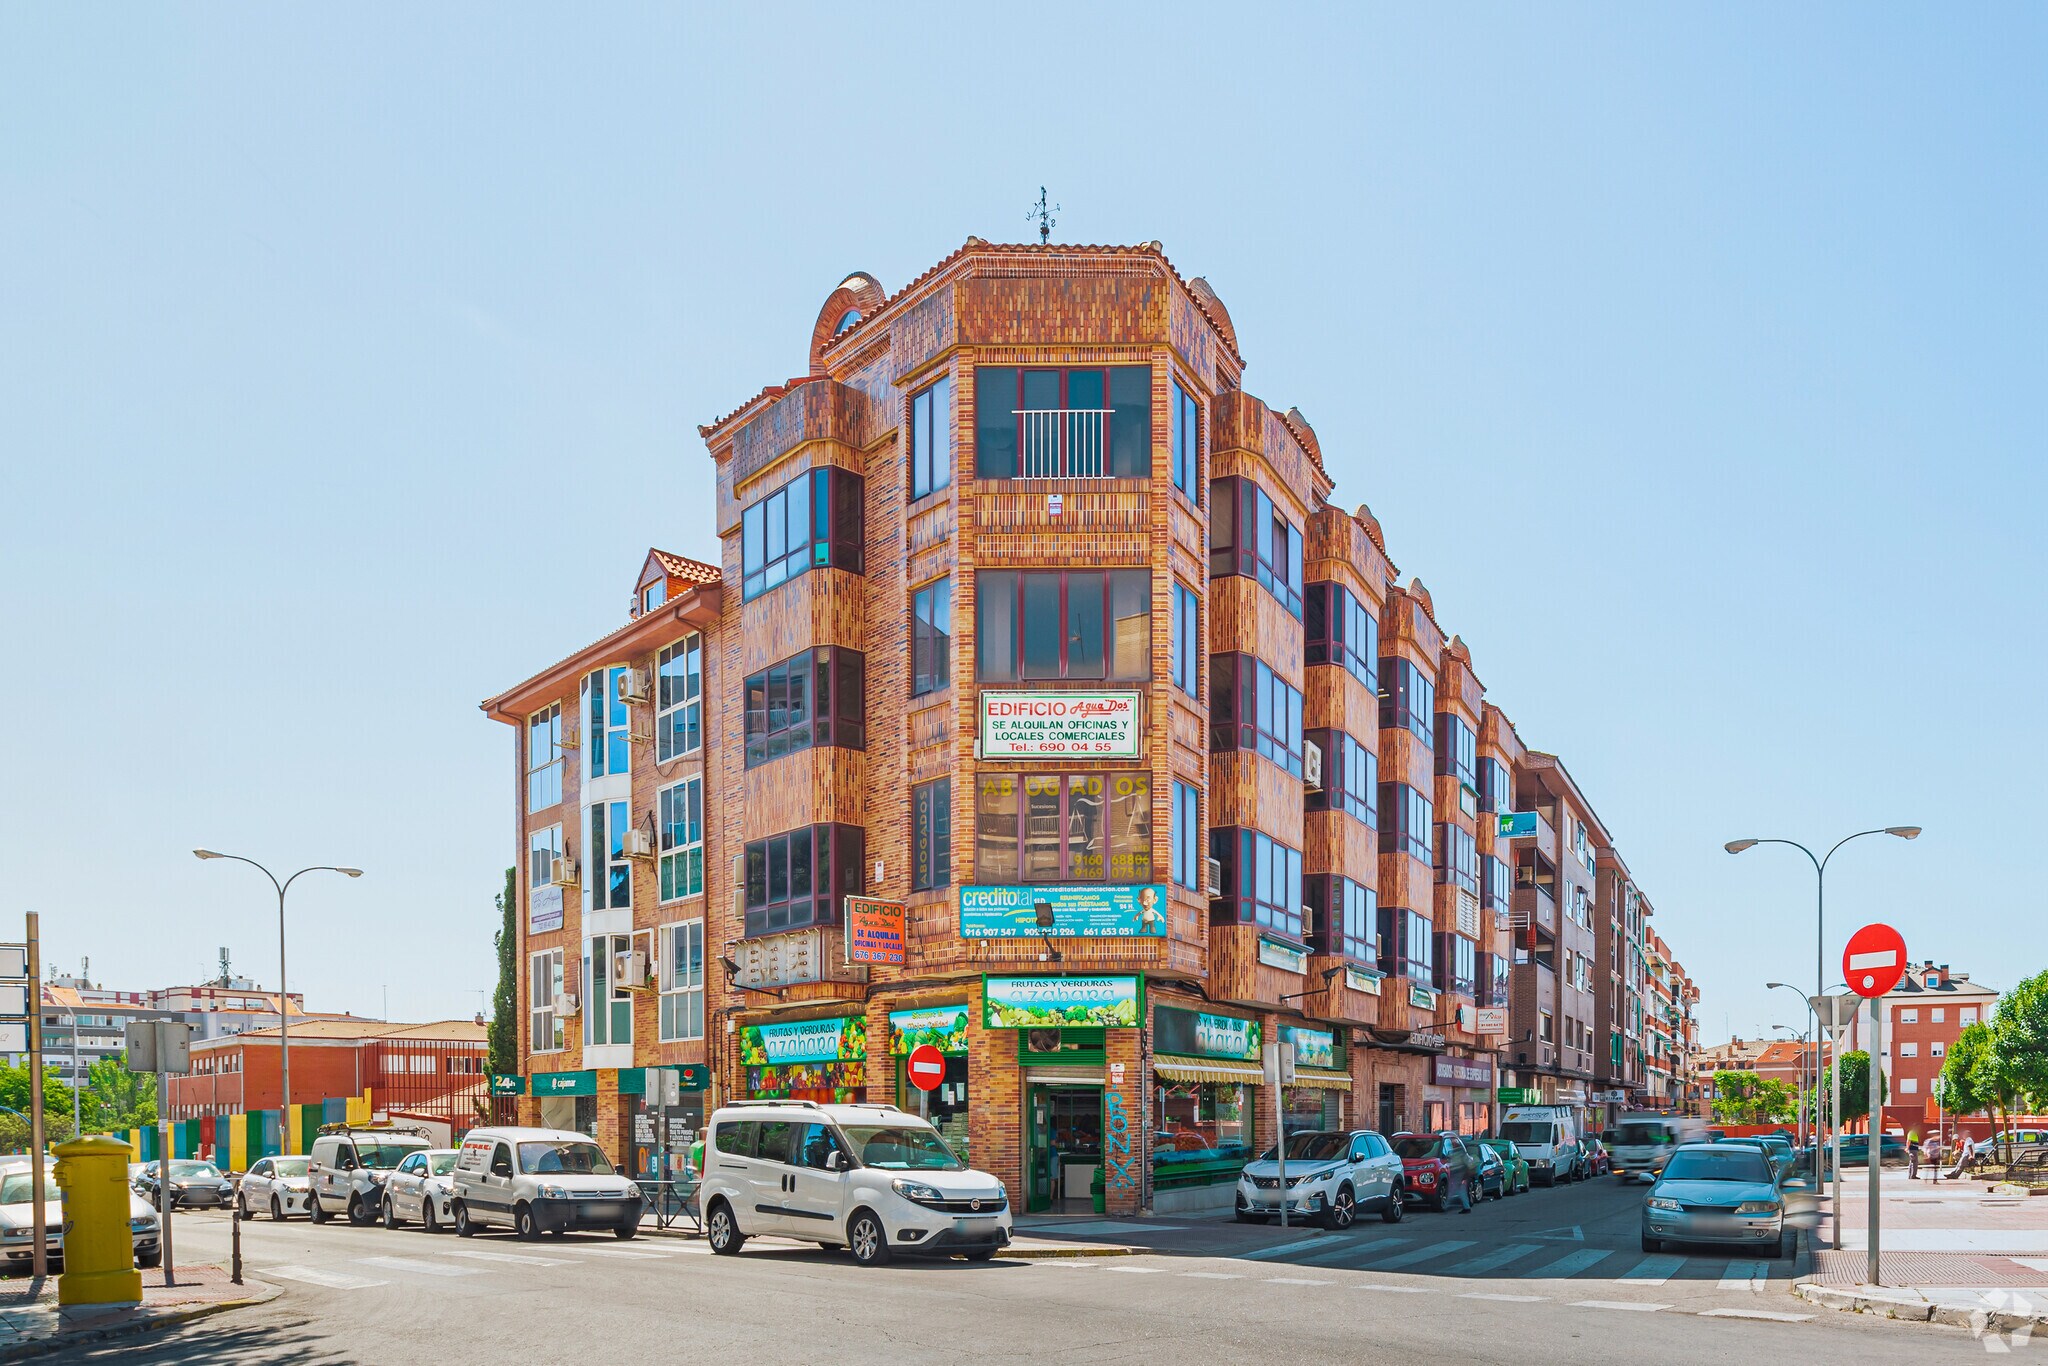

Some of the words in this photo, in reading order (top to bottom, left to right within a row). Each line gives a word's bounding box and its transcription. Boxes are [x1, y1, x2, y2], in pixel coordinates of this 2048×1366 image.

[987, 702, 1067, 716] EDIFICIO
[1069, 701, 1105, 719] Agua
[992, 720, 1006, 729] SE
[1010, 720, 1064, 730] ALQUILAN
[1067, 720, 1117, 730] OFICINAS
[1121, 720, 1129, 729] Y
[995, 731, 1044, 741] LOCALES
[1048, 731, 1126, 741] COMERCIALES
[1009, 743, 1033, 752] Tel.:
[1039, 743, 1066, 752] 690
[1071, 743, 1089, 752] 04
[1094, 743, 1112, 752] 55
[919, 789, 928, 885] ABOGADOS
[962, 887, 1033, 907] creditotal
[855, 902, 902, 917] EDIFICIO
[857, 929, 865, 938] SE
[867, 931, 900, 941] ALQUILAN
[965, 928, 981, 936] 916
[982, 928, 999, 936] 907
[1000, 928, 1017, 936] 547
[1059, 928, 1076, 936] 226
[1083, 927, 1099, 936] 661
[1101, 927, 1117, 936] 653
[1118, 927, 1135, 936] 051
[854, 949, 869, 960] 676
[871, 951, 887, 961] 367
[889, 953, 904, 963] 230
[1011, 980, 1049, 988] FRUTAS
[1059, 980, 1113, 988] VERDURAS
[769, 1027, 793, 1038] FRUTAS
[793, 1026, 799, 1036] Y
[799, 1023, 836, 1036] VERDURAS
[495, 1076, 516, 1089] 24h
